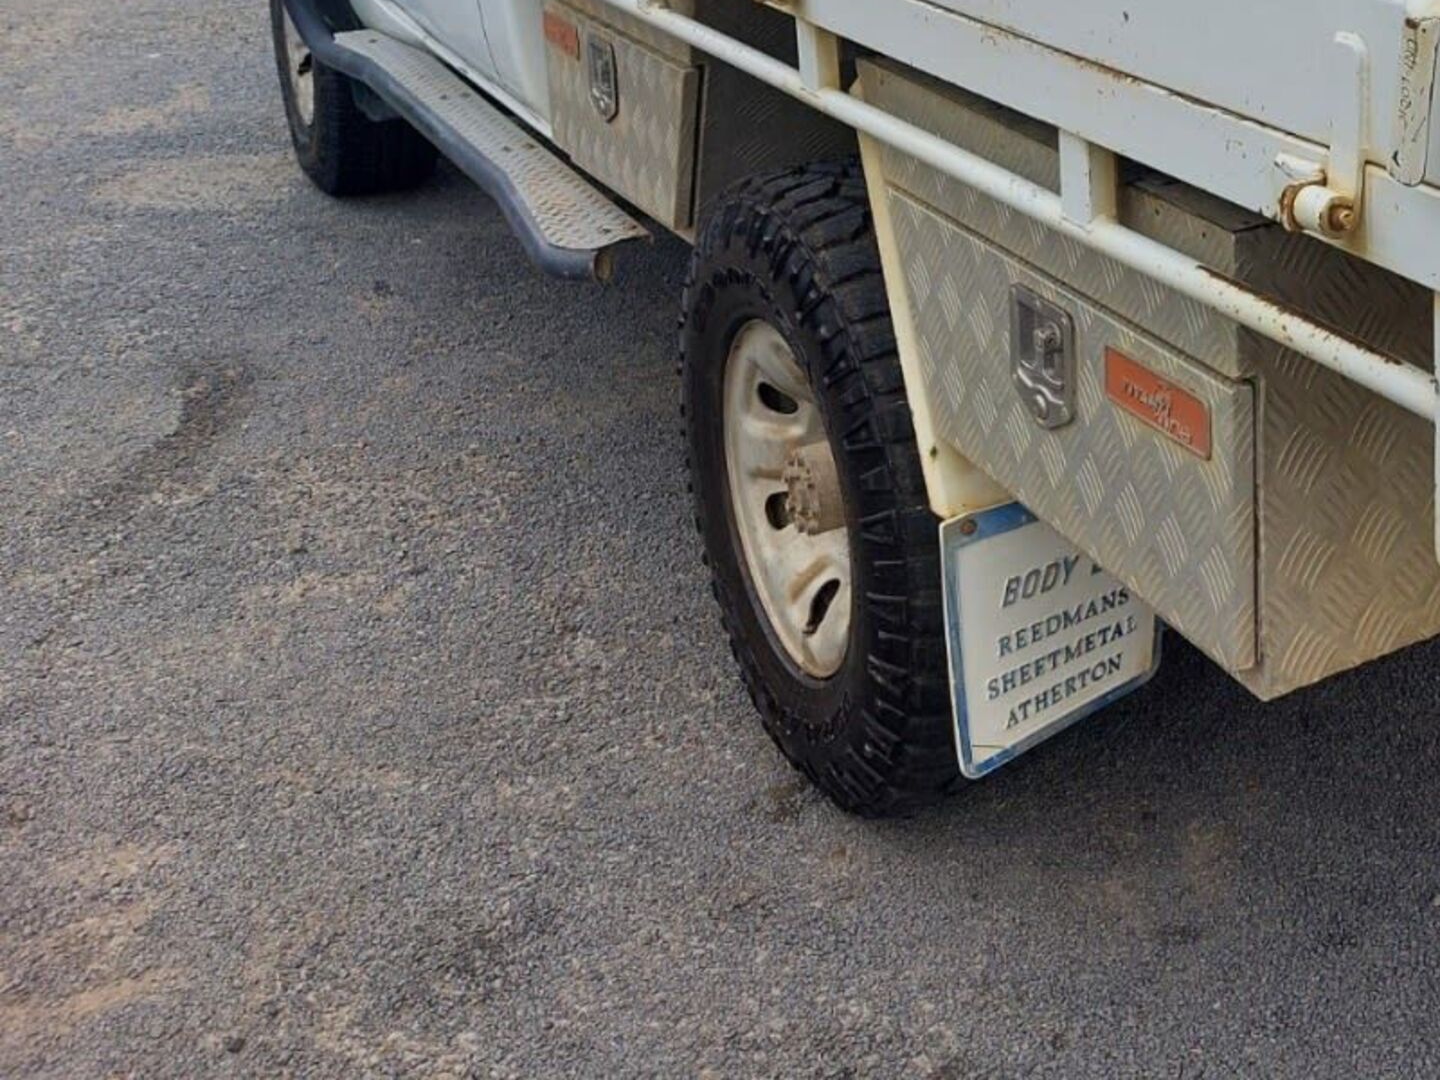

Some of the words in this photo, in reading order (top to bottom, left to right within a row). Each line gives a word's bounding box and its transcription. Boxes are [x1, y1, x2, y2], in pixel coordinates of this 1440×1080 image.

[1002, 554, 1080, 608] BODY
[987, 614, 1137, 700] SHEETMETAL
[998, 586, 1130, 658] REEDMANS
[1005, 652, 1123, 729] ATHERTON
